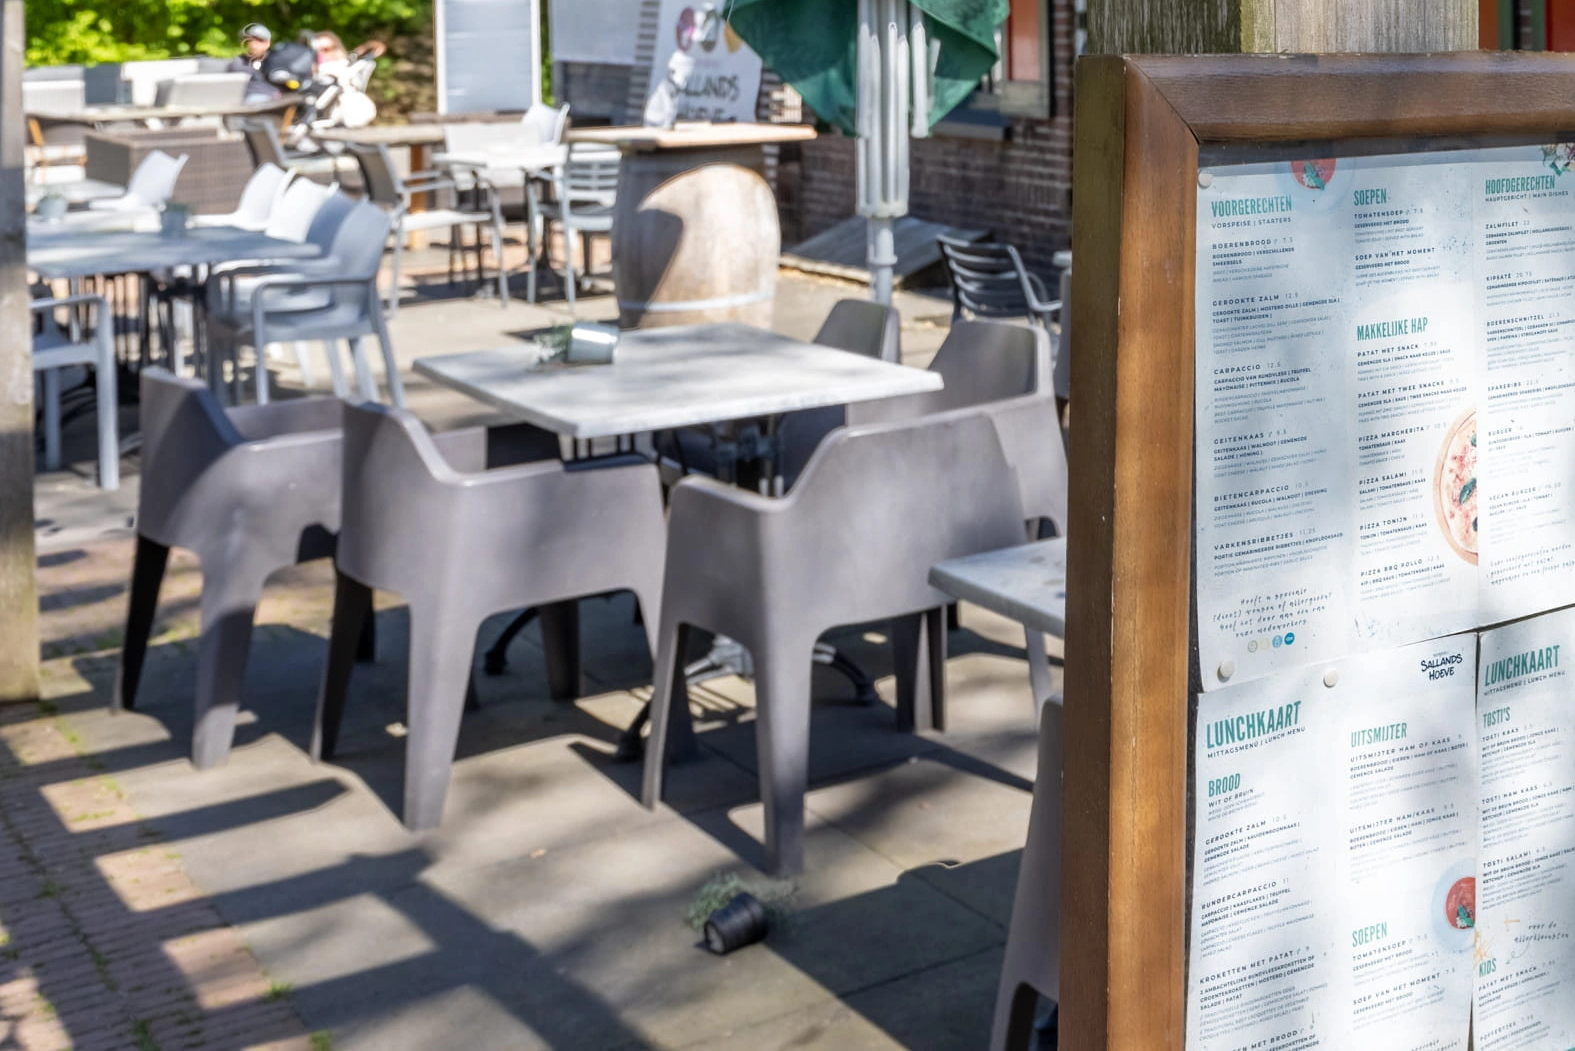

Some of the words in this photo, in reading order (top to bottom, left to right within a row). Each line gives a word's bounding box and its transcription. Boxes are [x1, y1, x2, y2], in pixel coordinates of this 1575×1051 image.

[1485, 175, 1556, 195] HOOFDGERECHTEN
[1353, 188, 1387, 206] SOEPEN
[1532, 191, 1547, 199] MAIN
[1211, 195, 1292, 218] VOORGERECHTEN
[1354, 209, 1404, 219] TOMATENSOEP
[1212, 220, 1251, 229] VORSPEISE
[1258, 216, 1292, 225] STARTERS
[1212, 239, 1272, 250] BOERENBROOD
[1355, 253, 1372, 261] SOEP
[1375, 251, 1390, 259] VAN
[1407, 247, 1435, 256] MOMENT
[1212, 296, 1255, 307] GEROOKTE
[1259, 294, 1280, 302] ZALM
[1357, 319, 1409, 341] MAKKELIJKE
[1411, 317, 1428, 334] HAP
[1357, 348, 1378, 357] PATAT
[1381, 346, 1394, 354] MET
[1397, 343, 1418, 352] SNACK
[1214, 363, 1261, 375] CARPACCIO
[1358, 389, 1380, 398] PATAT
[1382, 387, 1396, 395] MET
[1398, 384, 1416, 392] TWEE
[1419, 380, 1444, 389] SNACKS
[1214, 432, 1264, 445] GEITENKAAS
[1358, 433, 1378, 442] PIZZA
[1381, 426, 1424, 439] MARGHERITA
[1359, 476, 1379, 485] PIZZA
[1382, 471, 1407, 481] SALAMI
[1214, 485, 1289, 502] BIETENCARPACCIO
[1360, 521, 1380, 530] PIZZA
[1383, 516, 1408, 526] TONIJN
[1214, 532, 1294, 551] VARKENSRIBBETJES
[1360, 567, 1381, 577] PIZZA
[1384, 563, 1398, 572] BBQ
[1401, 558, 1423, 568] POLLO
[1420, 653, 1463, 672] SALLANDS
[1485, 645, 1560, 687] LUNCHKAART
[1428, 667, 1455, 681] HOEVE
[1527, 674, 1548, 686] LUNCH
[1206, 700, 1302, 749] LUNCHKAART
[1483, 706, 1511, 729] TOSTI'S
[1264, 731, 1286, 744] LUNCH
[1287, 725, 1306, 737] MENU
[1350, 722, 1408, 748] UITSMIJTER
[1350, 748, 1396, 762] UITSMIJTER
[1399, 743, 1416, 752] HAM
[1432, 736, 1452, 746] KAAS
[1208, 773, 1241, 798] BROOD
[1208, 798, 1222, 808] WIT
[1224, 794, 1234, 803] OF
[1234, 788, 1254, 800] BRUIN
[1205, 827, 1244, 845] GEROOKTE
[1247, 820, 1266, 832] ZALM
[1482, 857, 1503, 868] TOSTI
[1506, 850, 1531, 862] SALAMI
[1202, 880, 1278, 910] RUNDERCARPACCIO
[1352, 921, 1388, 948] SOEPEN
[1353, 939, 1406, 961] TOMATENSOEP
[1200, 964, 1248, 984] KROKETTEN
[1250, 959, 1266, 969] MET
[1269, 950, 1294, 963] PATAT
[1479, 958, 1496, 977] KIDS
[1353, 994, 1372, 1006] SOEP
[1375, 988, 1390, 999] VAN
[1393, 983, 1408, 993] HET
[1410, 972, 1441, 987] MOMENT
[1251, 1039, 1266, 1050] MET
[1269, 1029, 1298, 1044] BROOD
